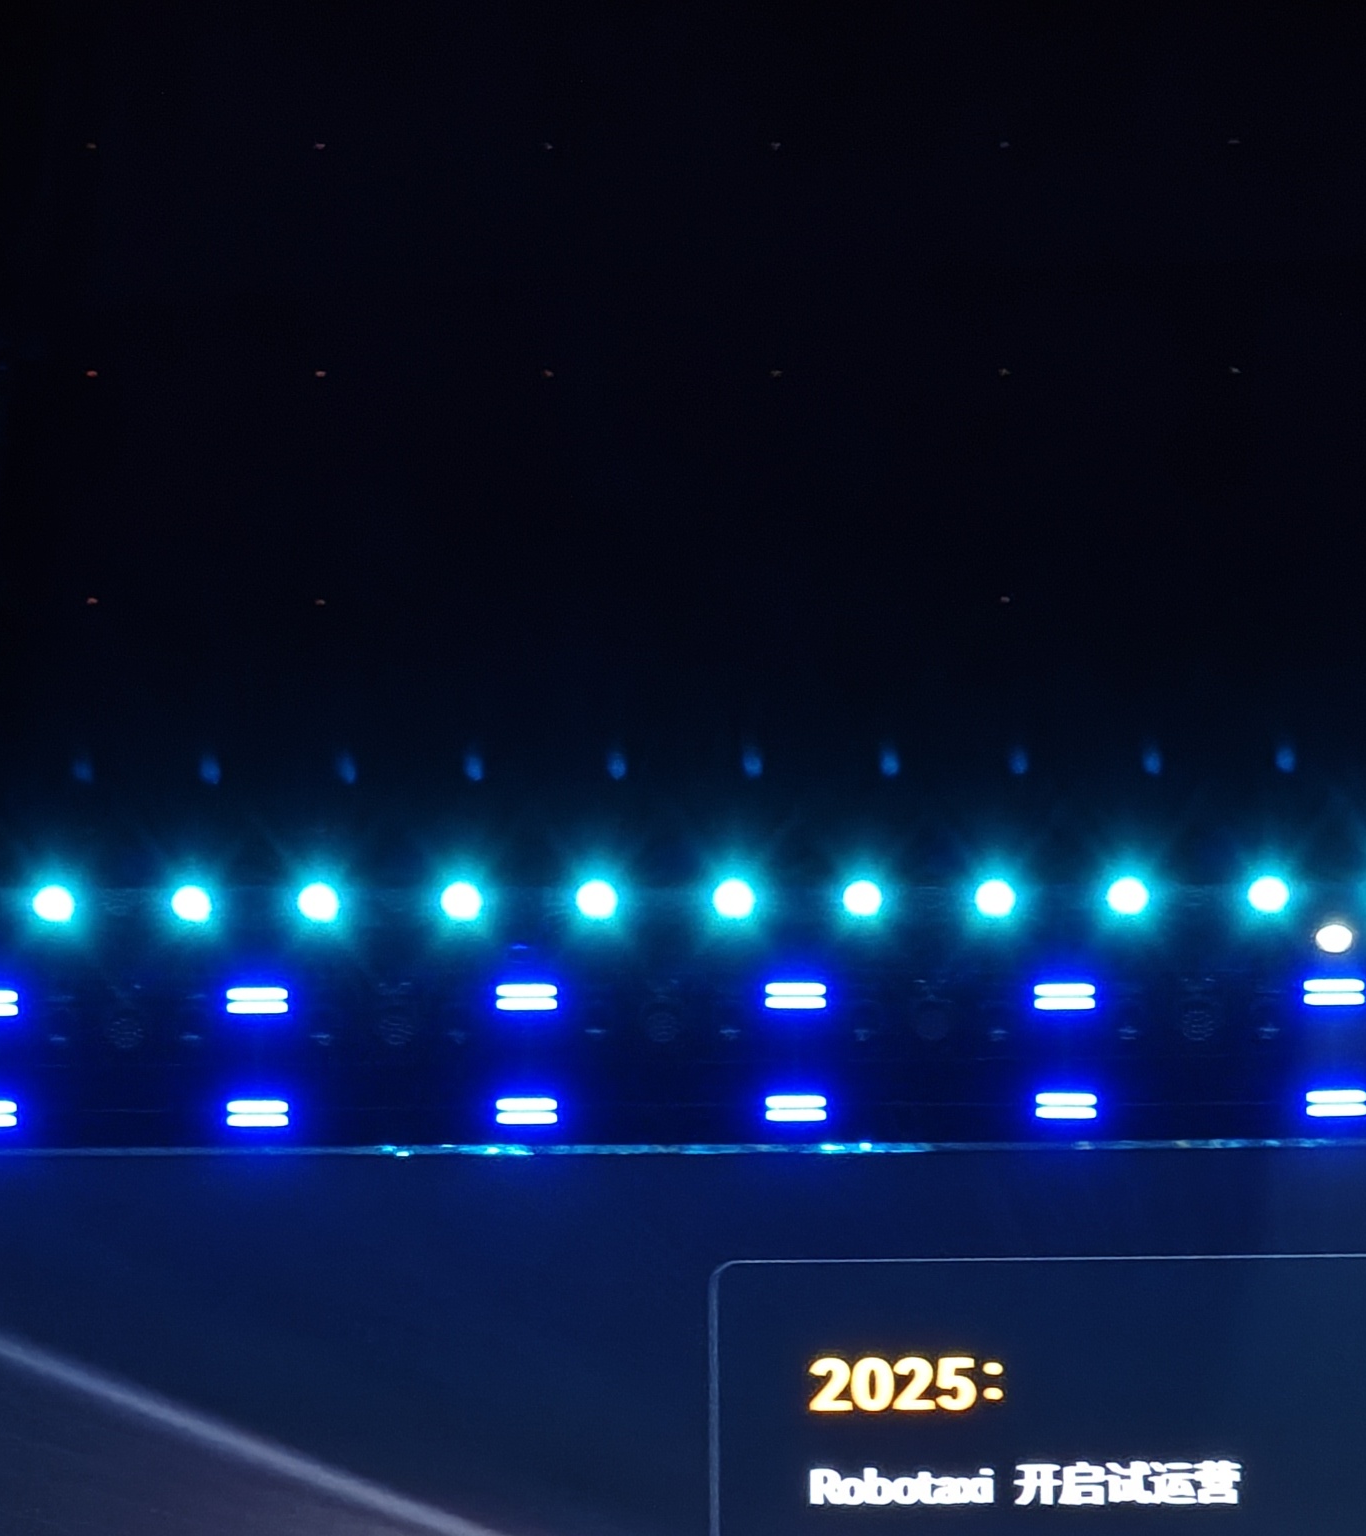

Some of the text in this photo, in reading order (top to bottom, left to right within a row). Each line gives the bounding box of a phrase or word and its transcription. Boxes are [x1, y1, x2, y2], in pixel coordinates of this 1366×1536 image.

[808, 1356, 1004, 1412] 2025:
[809, 1459, 1243, 1506] Robotaxi 开启试运营
